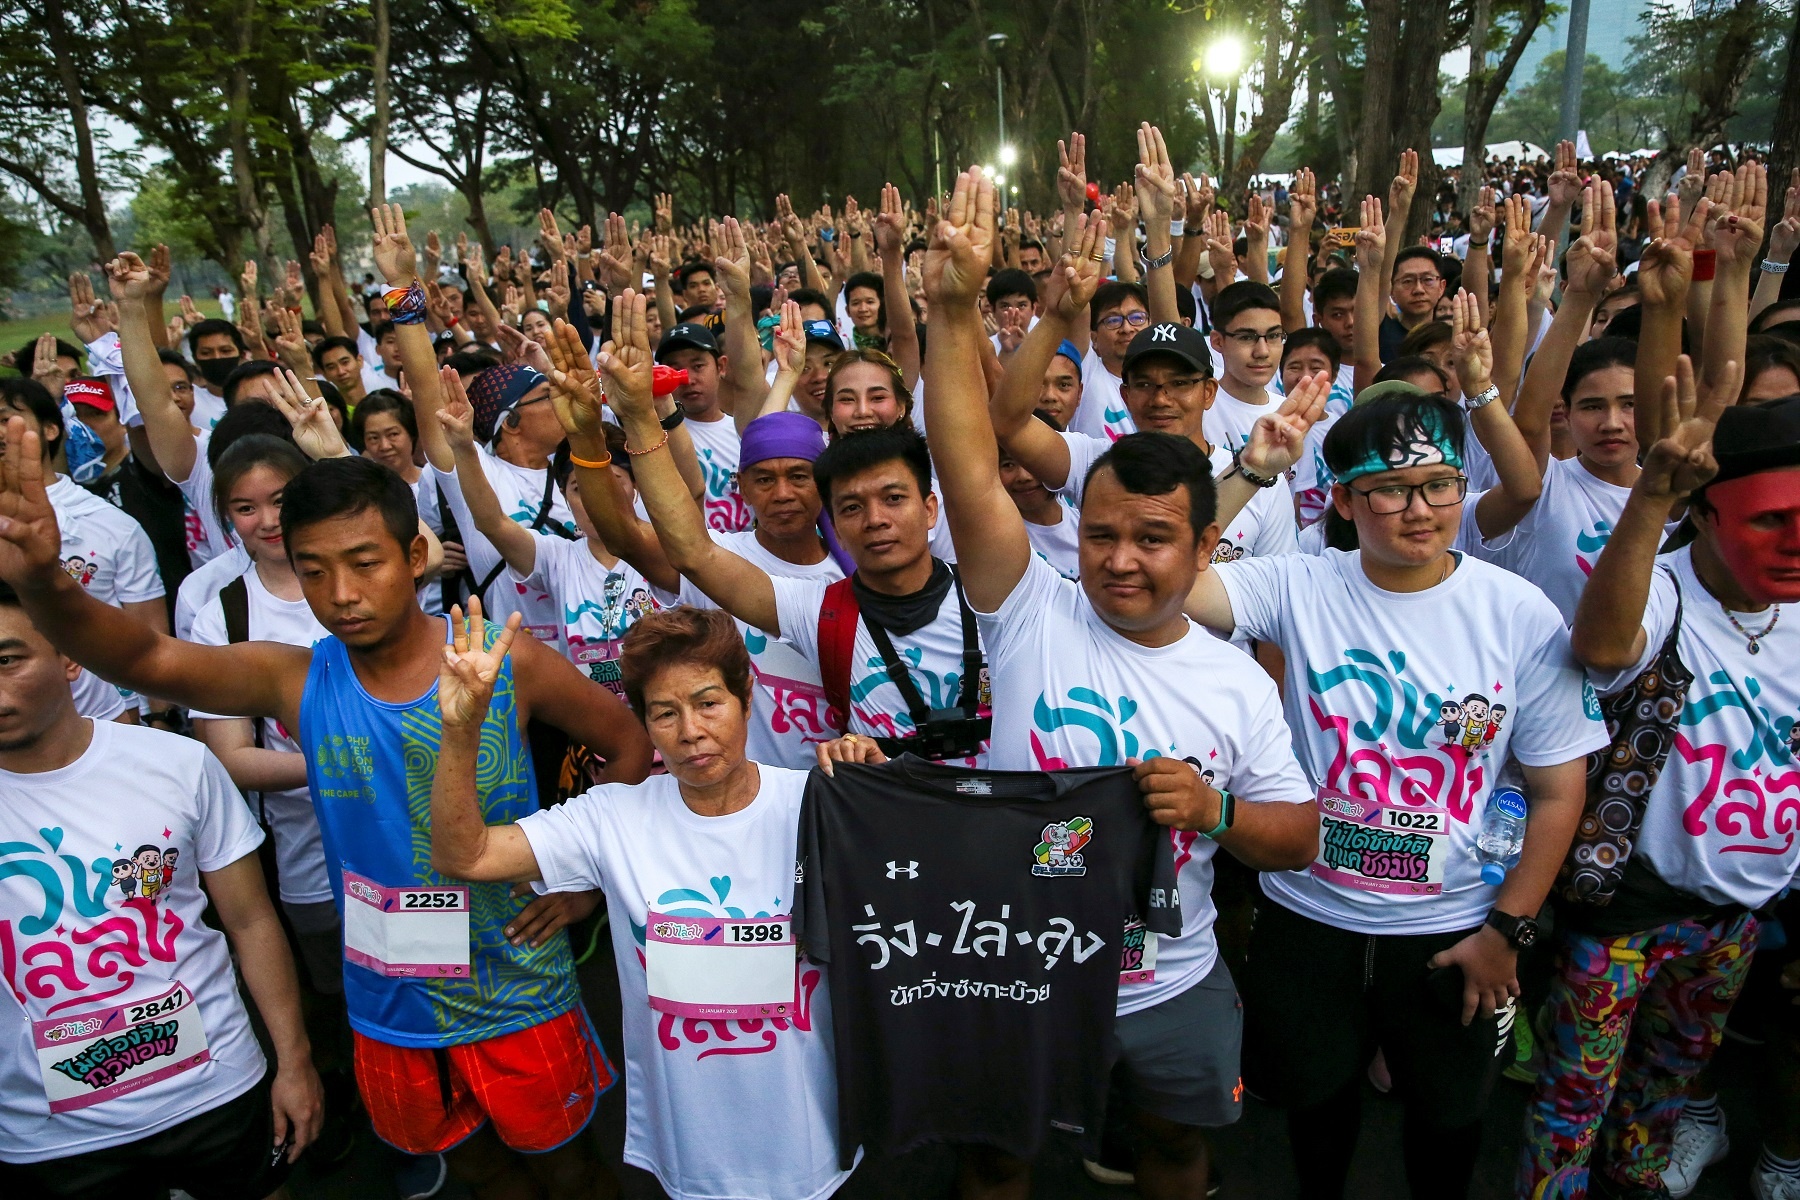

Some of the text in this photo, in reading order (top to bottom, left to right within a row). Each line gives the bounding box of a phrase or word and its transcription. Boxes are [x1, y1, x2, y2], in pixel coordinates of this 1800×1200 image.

[320, 789, 359, 798] THE CAPE
[1389, 811, 1439, 830] 1022
[405, 893, 459, 908] 2252
[731, 924, 783, 942] 1398
[130, 989, 183, 1022] 2847
[112, 1086, 119, 1094] 12
[119, 1080, 141, 1093] JANUARY
